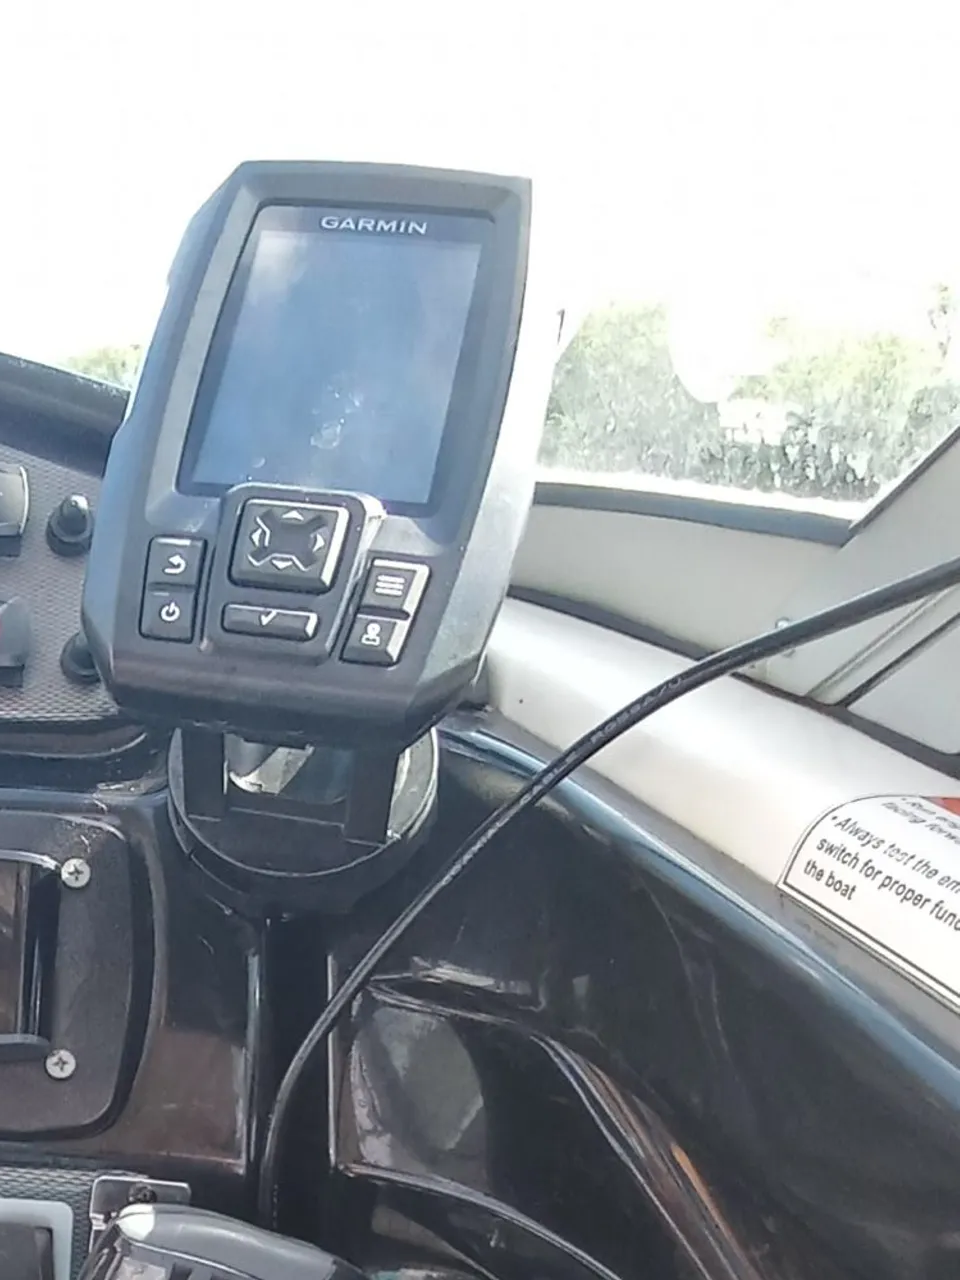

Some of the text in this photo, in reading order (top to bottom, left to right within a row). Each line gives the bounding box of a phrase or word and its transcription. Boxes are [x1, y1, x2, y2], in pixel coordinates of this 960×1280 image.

[321, 216, 428, 235] GARMIN
[816, 838, 860, 869] switch
[858, 858, 883, 882] for
[877, 875, 931, 908] proper
[835, 817, 885, 850] Always
[882, 843, 917, 866] test
[911, 858, 939, 880] the
[803, 858, 857, 900] the boat
